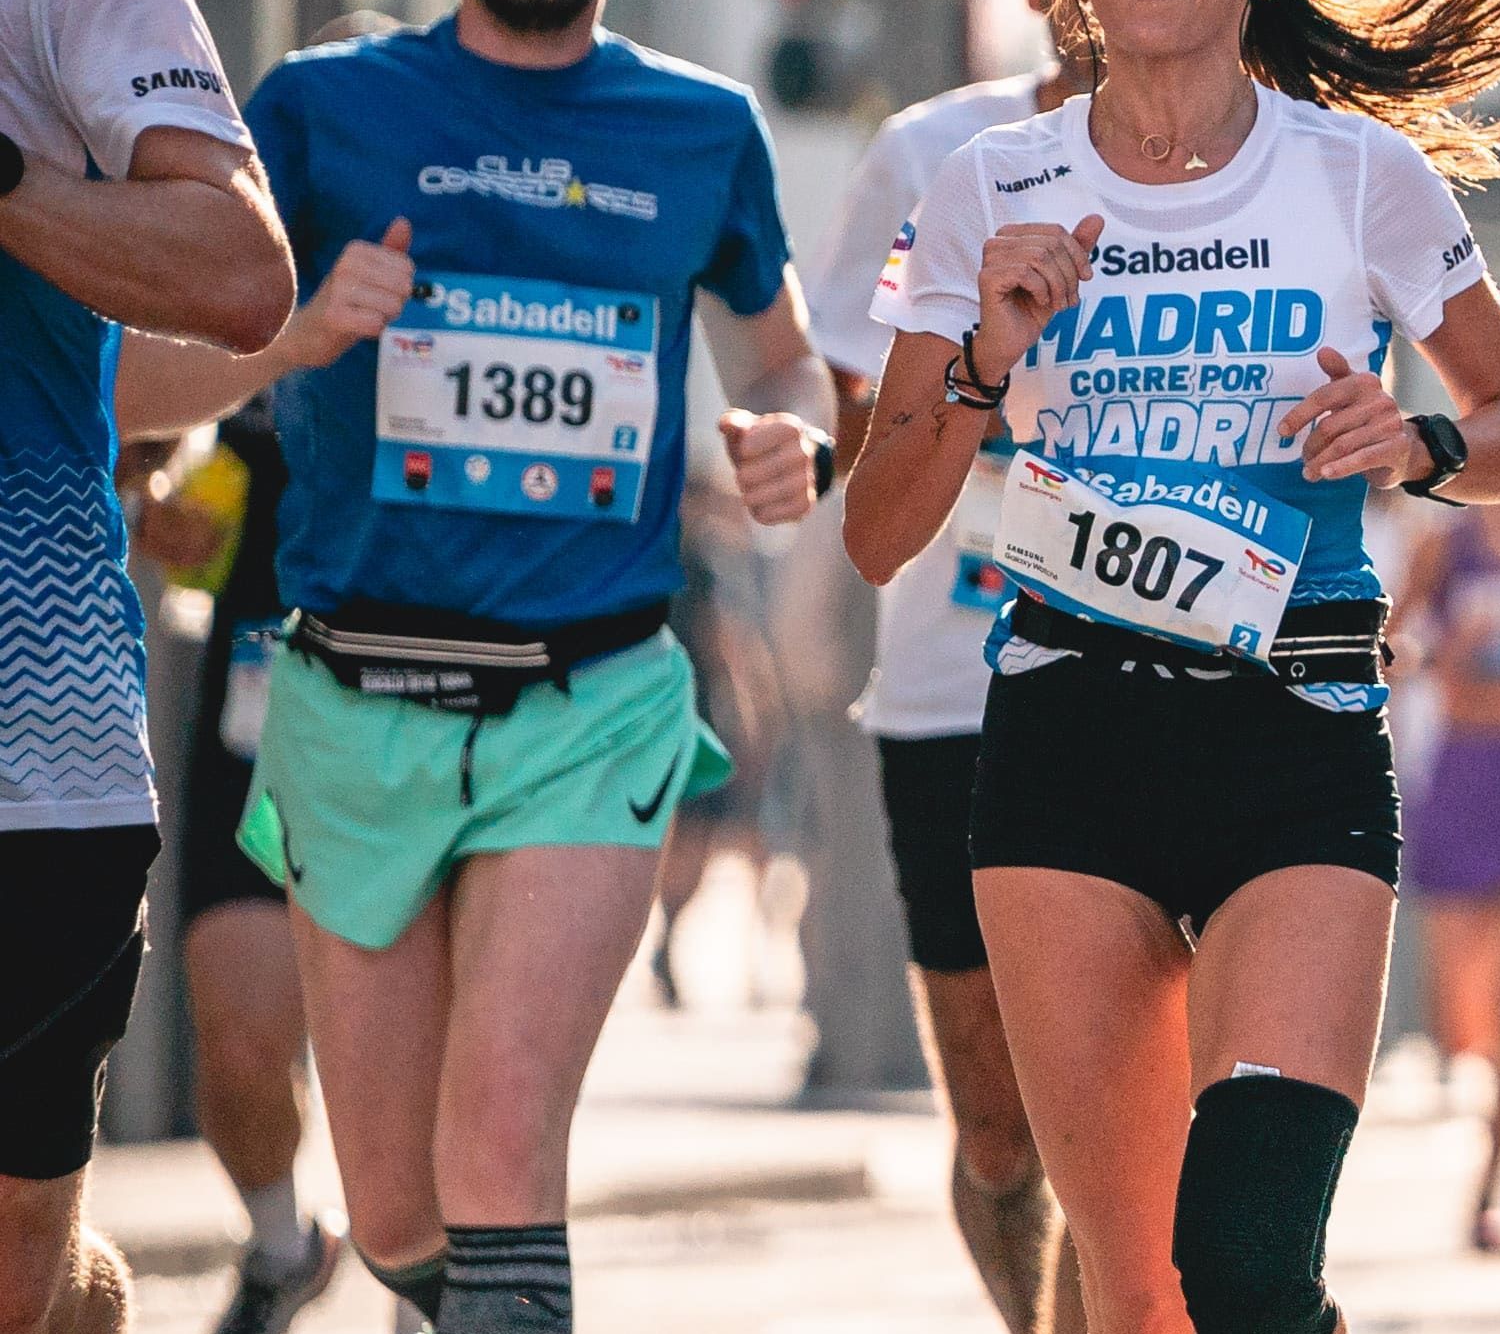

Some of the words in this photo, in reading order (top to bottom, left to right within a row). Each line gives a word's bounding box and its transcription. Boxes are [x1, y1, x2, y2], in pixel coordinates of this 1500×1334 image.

[996, 169, 1052, 193] luanvi
[1101, 239, 1270, 276] Sabadell
[445, 288, 618, 341] Sabadell
[1026, 289, 1323, 367] MADRID
[446, 362, 593, 427] 1389
[1071, 365, 1190, 397] CORRE
[1199, 363, 1267, 392] POR
[1091, 472, 1268, 535] Sabadell
[1006, 543, 1045, 564] SAMSUNG
[1068, 510, 1225, 613] 1807
